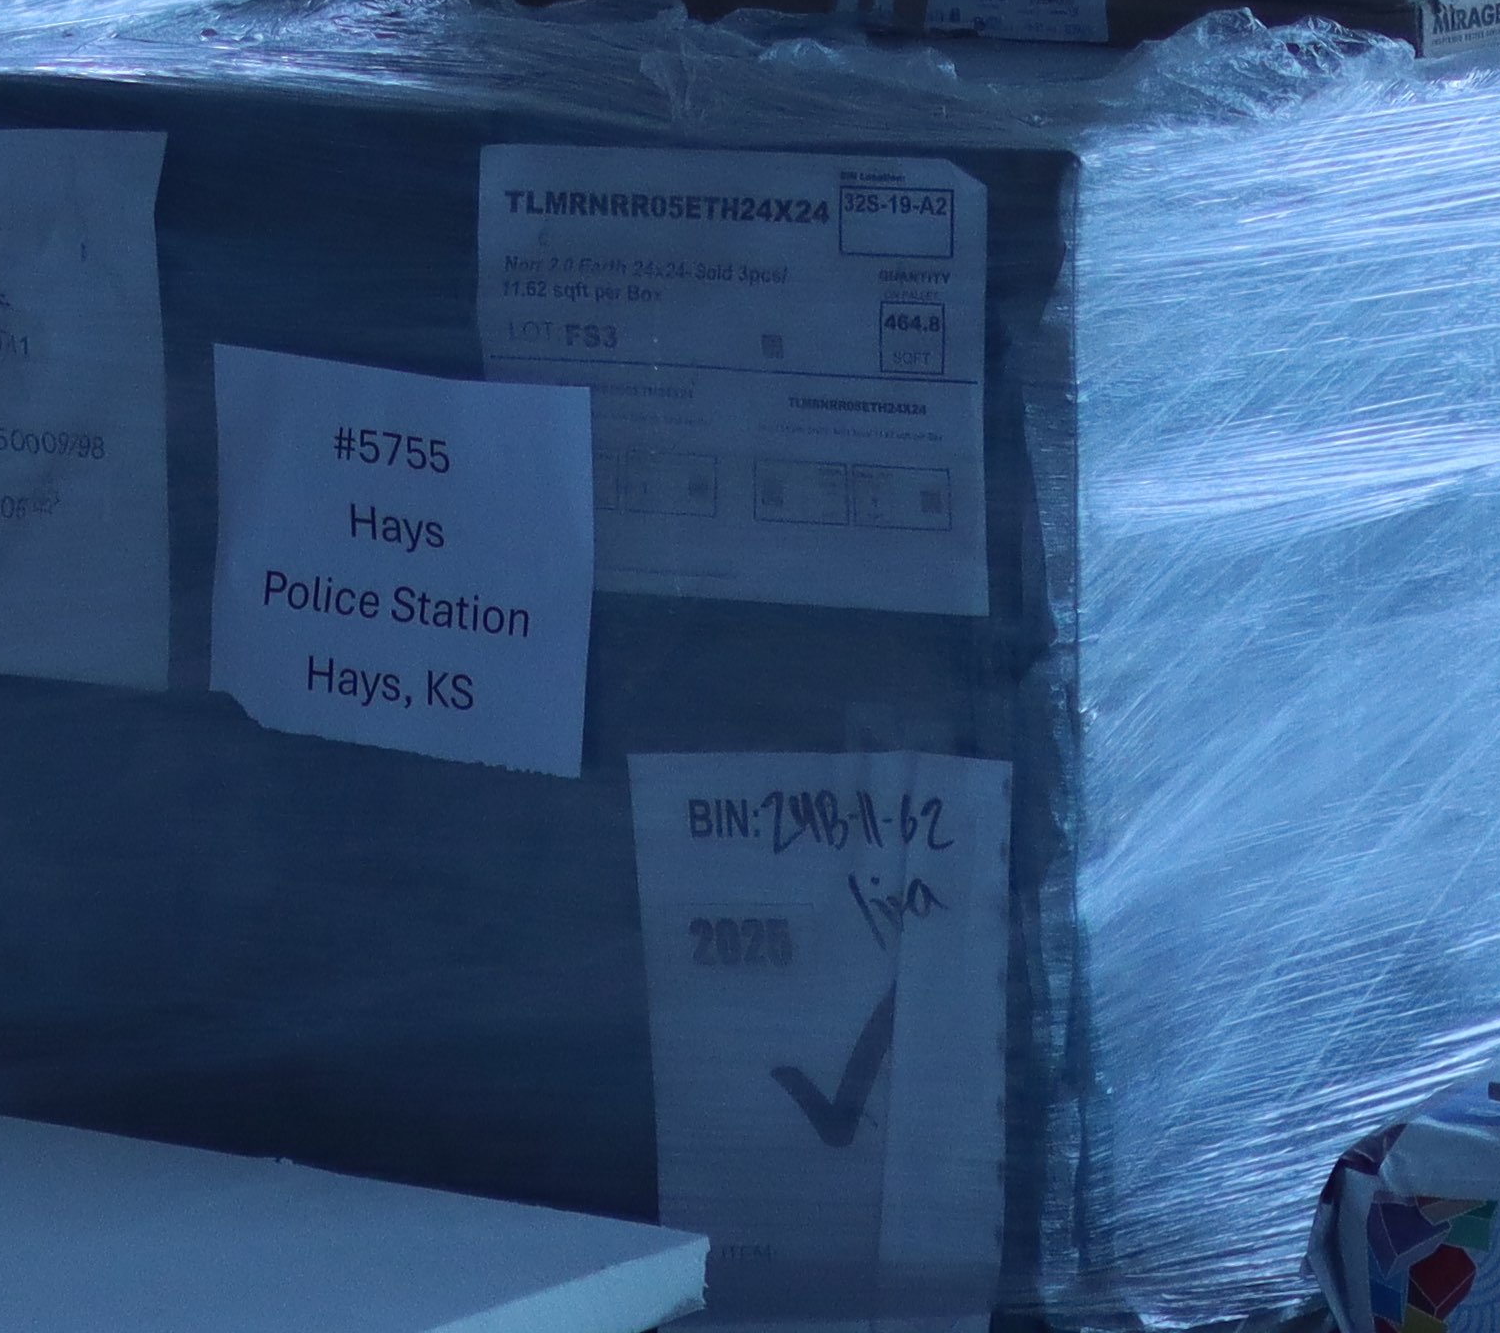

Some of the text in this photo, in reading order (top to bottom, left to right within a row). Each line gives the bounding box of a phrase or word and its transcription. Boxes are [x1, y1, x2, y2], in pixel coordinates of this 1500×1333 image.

[843, 193, 948, 217] 32S-19-A2
[695, 262, 733, 282] Sold
[879, 268, 951, 285] QUANTITY
[553, 282, 589, 303] sqft
[594, 286, 620, 303] per
[626, 284, 662, 302] Box
[883, 313, 941, 334] 464.8
[564, 323, 619, 350] FS3
[892, 351, 931, 366] SQFT
[333, 426, 450, 473] #5755
[350, 502, 446, 553] Hays
[262, 569, 530, 638] Police Station
[306, 654, 475, 712] Hays, KS
